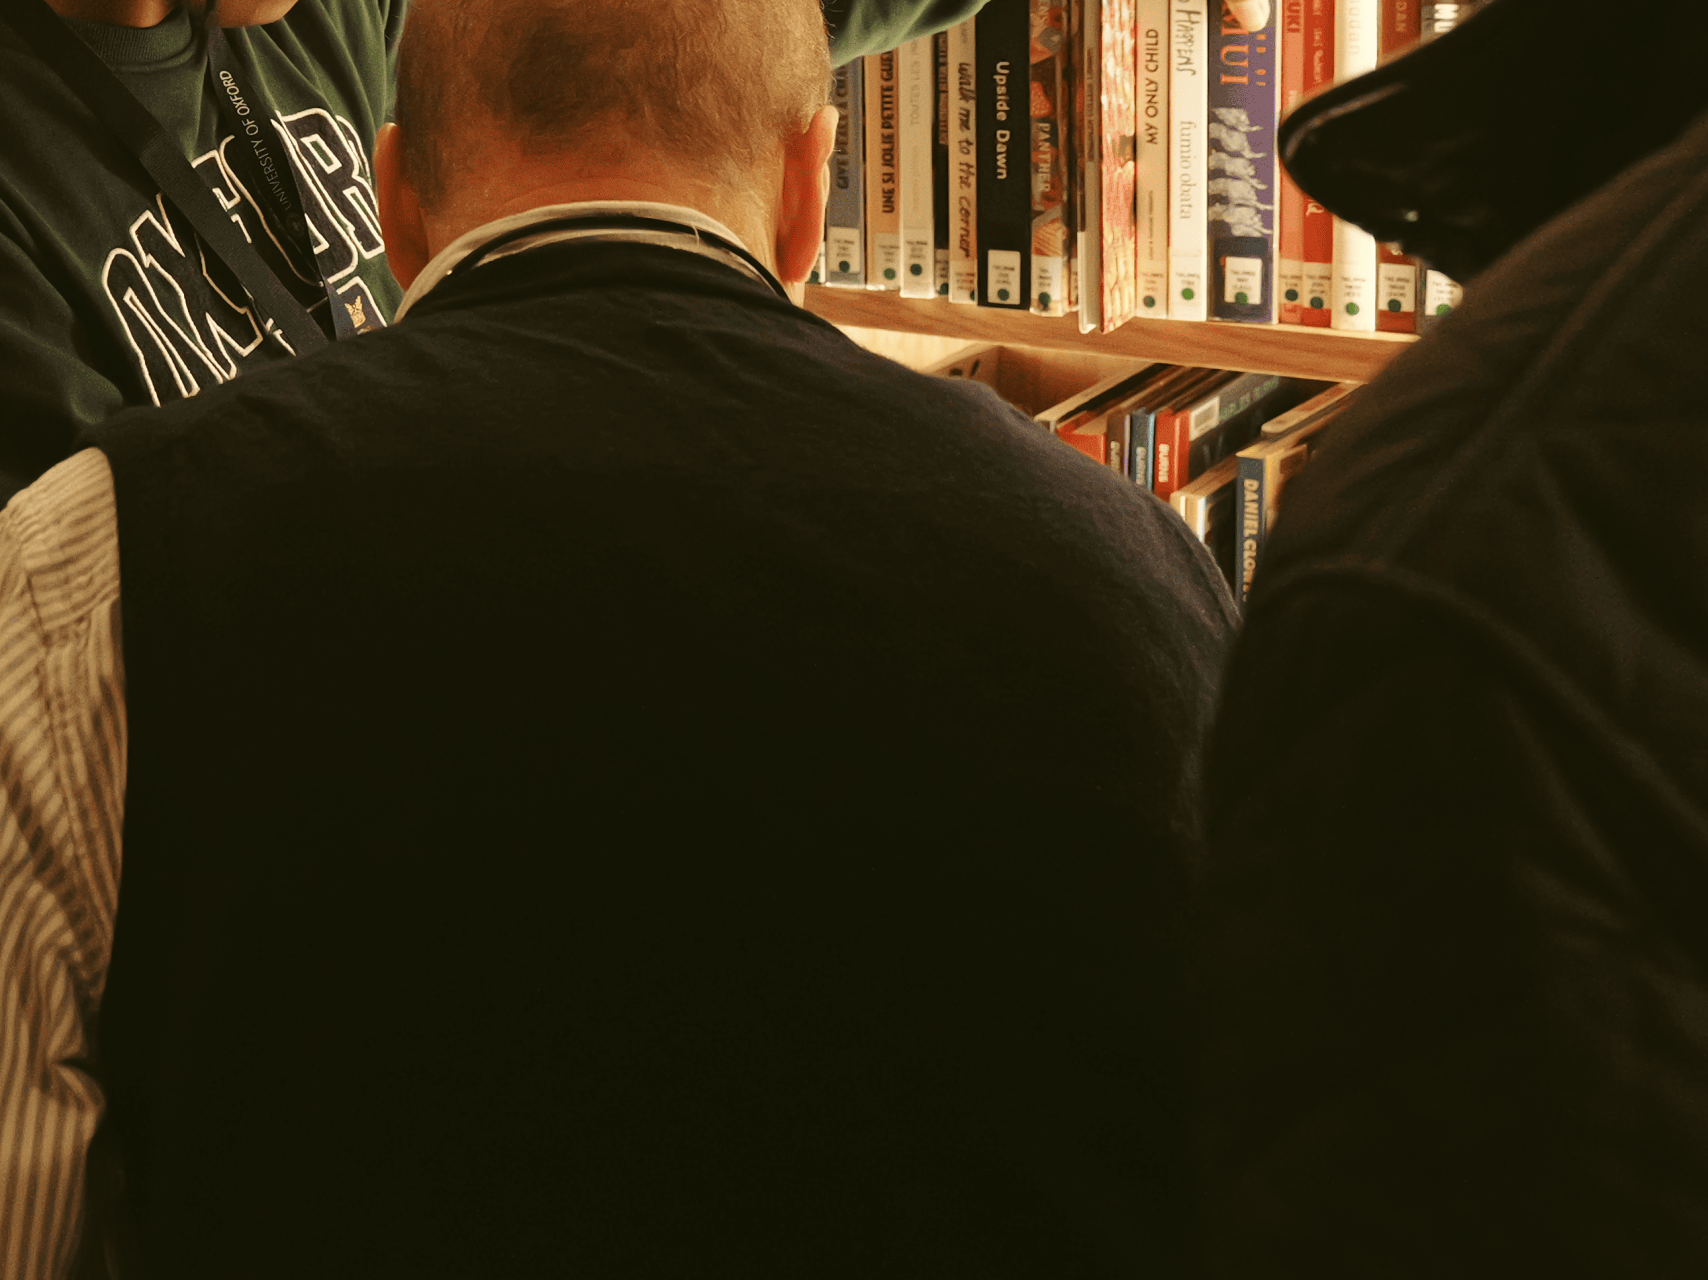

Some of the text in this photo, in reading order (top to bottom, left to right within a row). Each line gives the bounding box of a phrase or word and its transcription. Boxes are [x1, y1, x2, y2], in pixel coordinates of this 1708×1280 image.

[1144, 28, 1158, 146] MY ONLY CHILD
[219, 70, 292, 211] UNIVERSITY OF OXFORD
[959, 106, 973, 131] me
[959, 138, 974, 156] to
[992, 61, 1011, 180] Upside Dawn
[1178, 119, 1197, 171] fumio
[880, 85, 895, 214] UNE SI JOLIE PETITE
[958, 162, 975, 190] the
[1037, 122, 1053, 193] PANTHER
[1178, 172, 1197, 220] obata
[958, 196, 972, 259] corner
[1243, 478, 1259, 538] DANIEL
